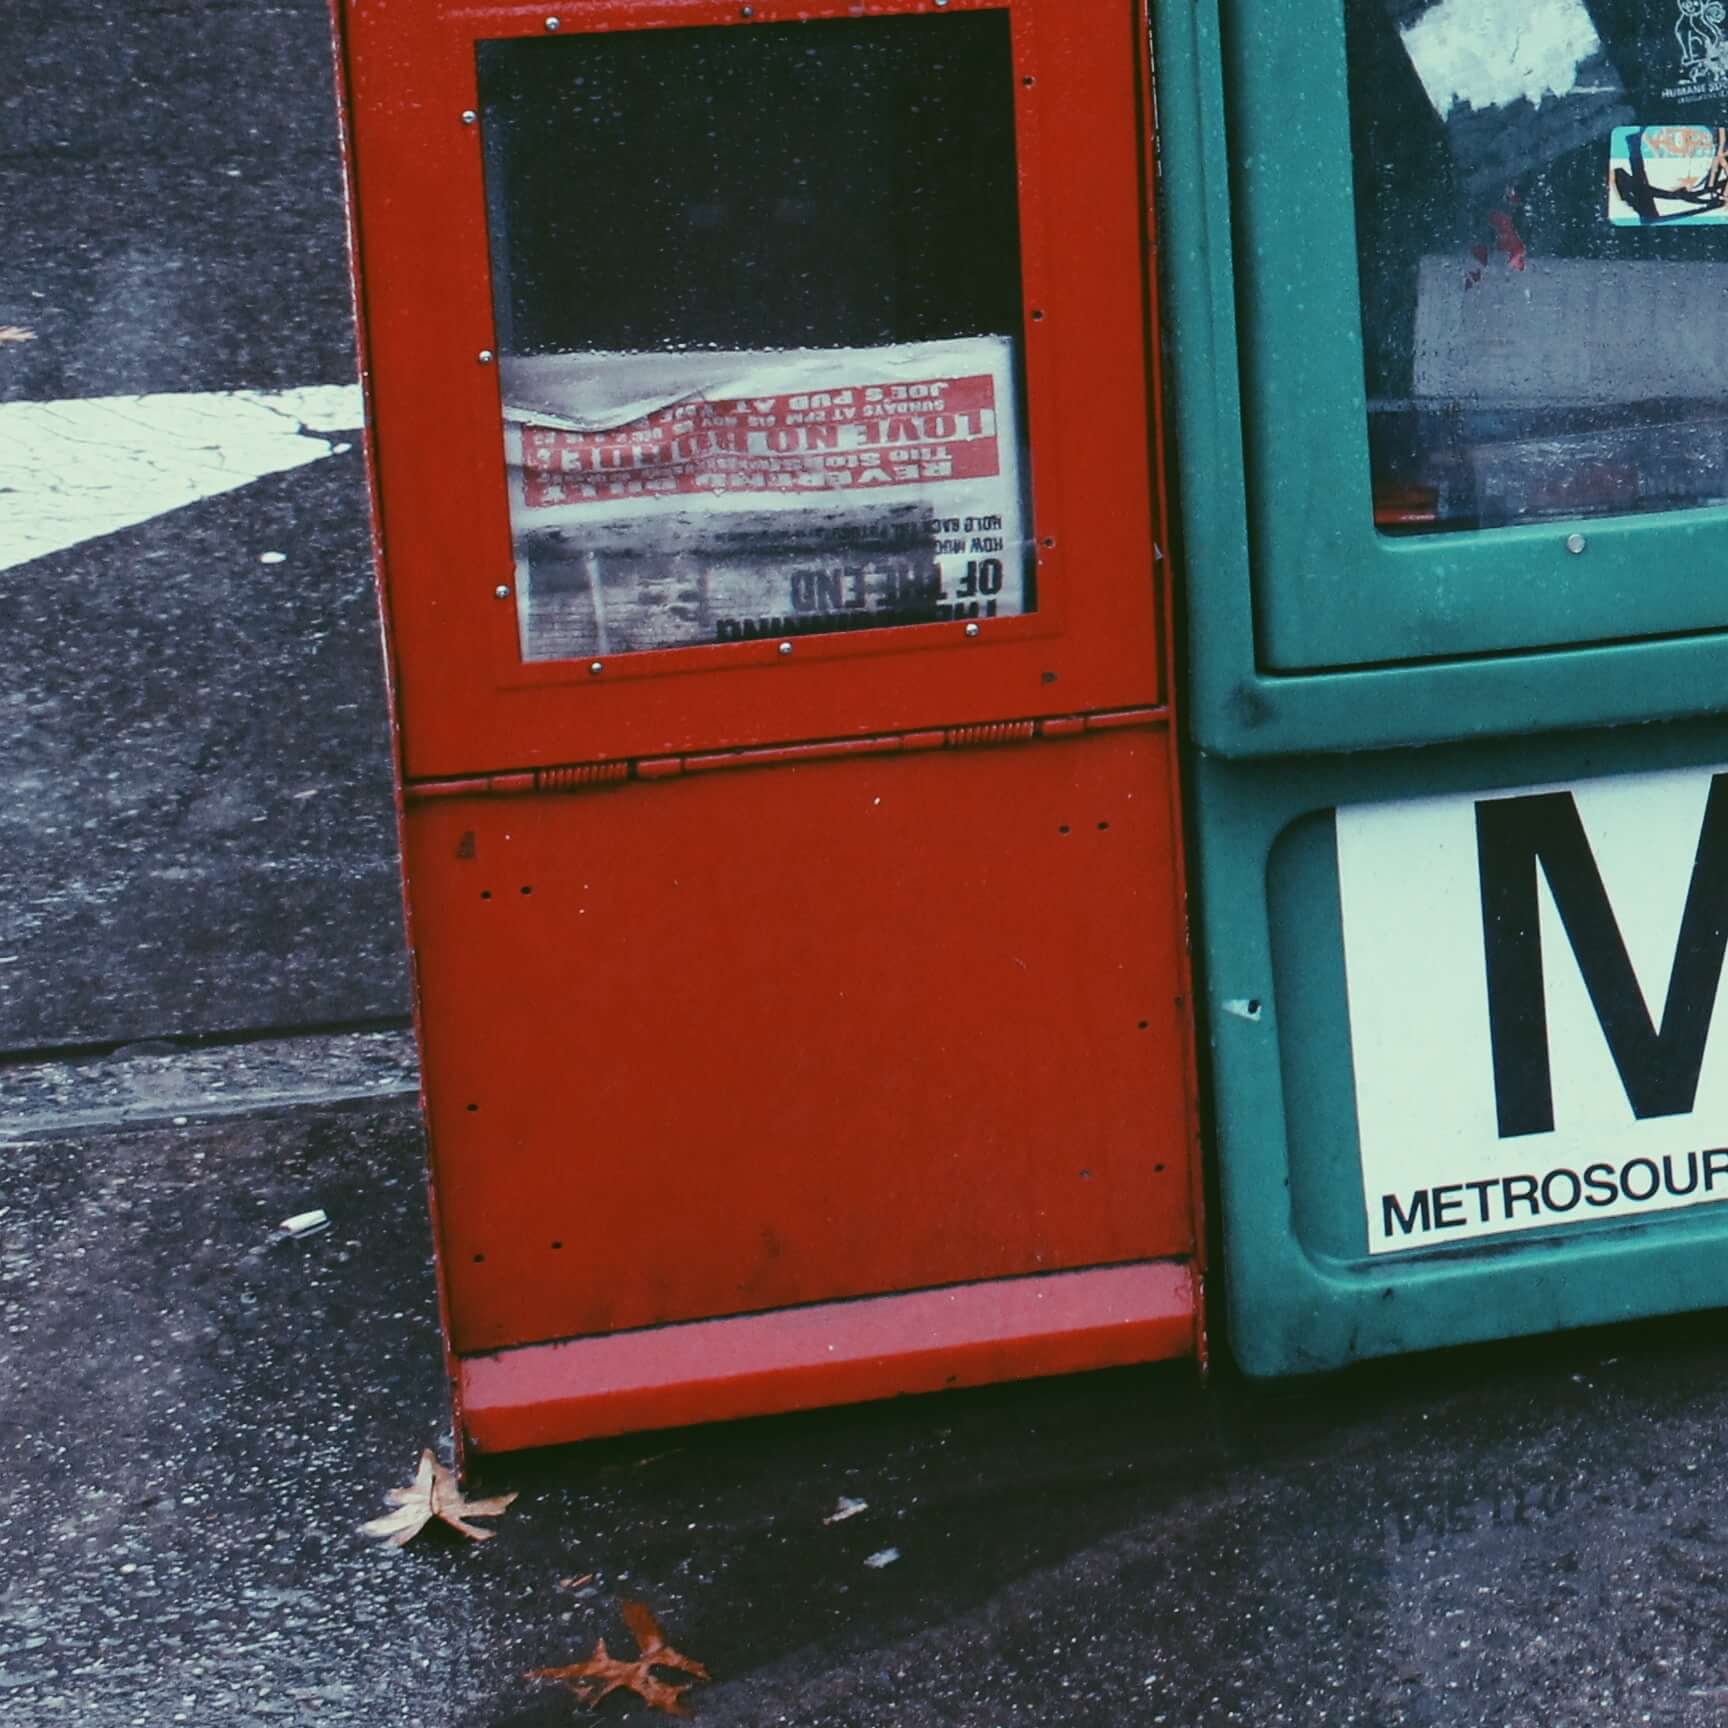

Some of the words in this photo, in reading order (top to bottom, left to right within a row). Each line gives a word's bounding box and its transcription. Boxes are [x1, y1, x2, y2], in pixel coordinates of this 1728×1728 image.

[863, 398, 946, 418] SUNDAYS
[790, 566, 866, 613] END
[955, 558, 1004, 601] OF
